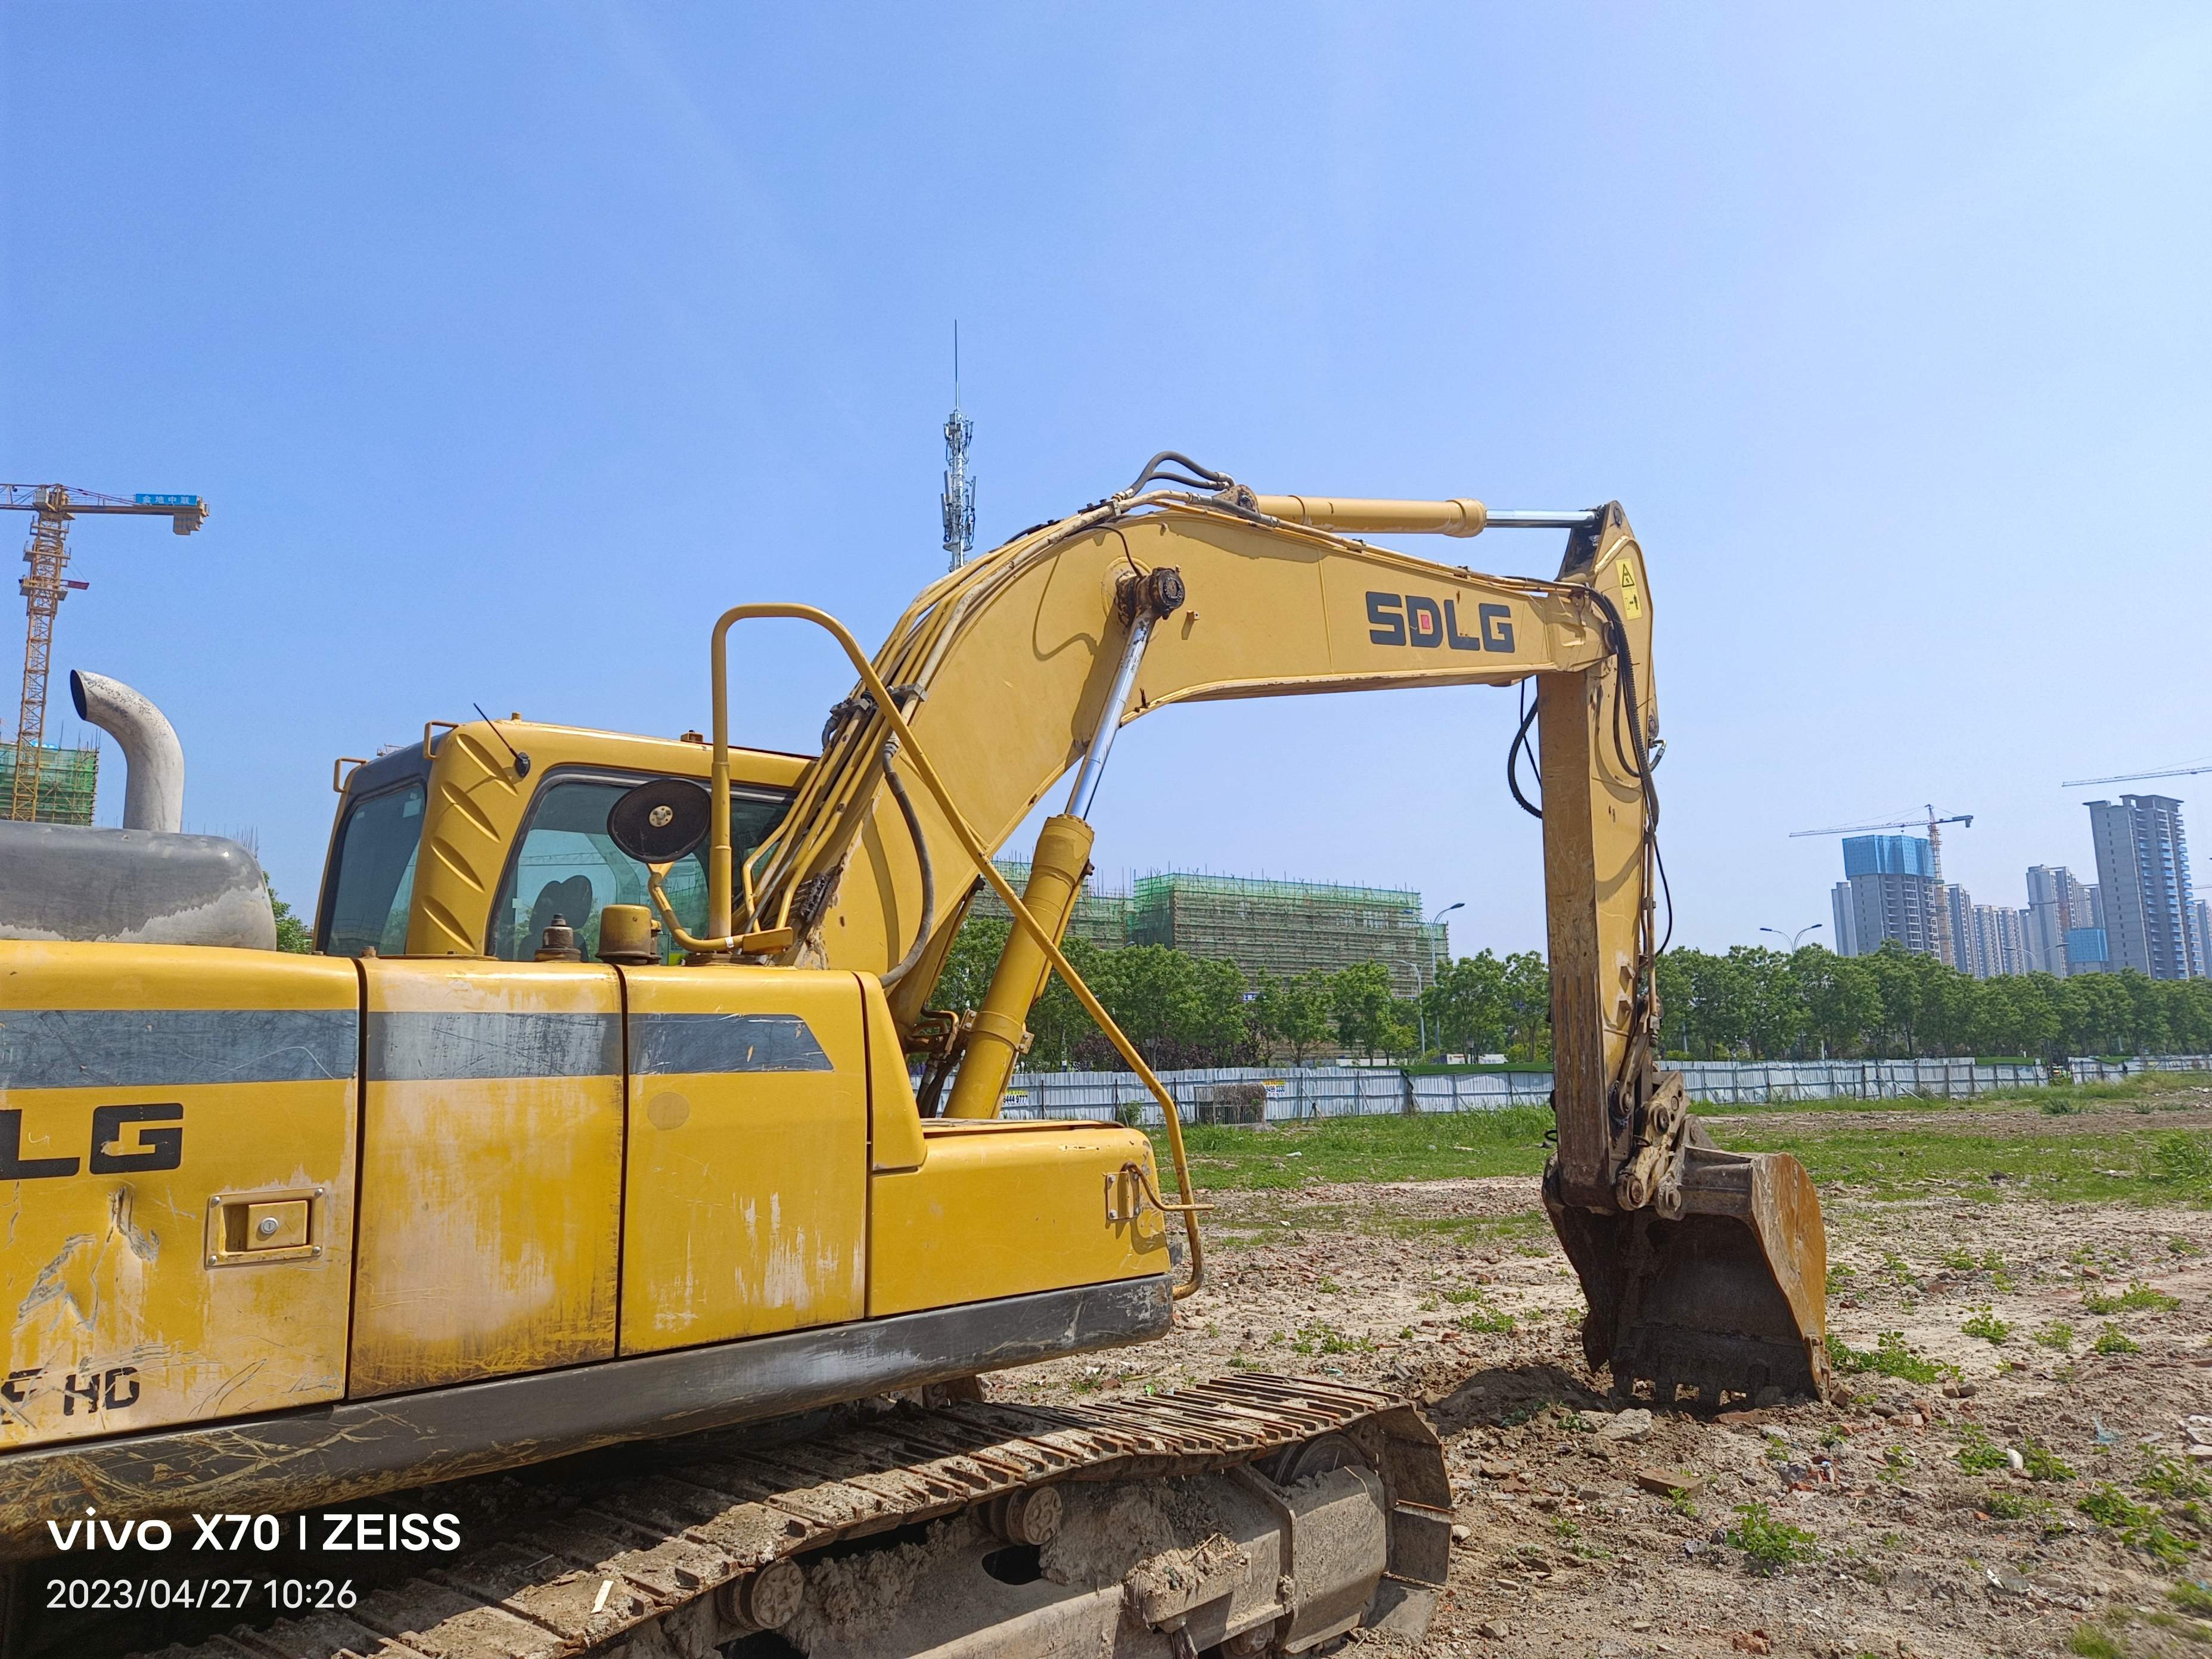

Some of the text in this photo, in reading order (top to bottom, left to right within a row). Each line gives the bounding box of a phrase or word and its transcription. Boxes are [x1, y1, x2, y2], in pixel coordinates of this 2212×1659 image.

[1366, 591, 1515, 653] SDLG
[1016, 1095, 1028, 1103] 9777
[64, 1366, 140, 1416] HD
